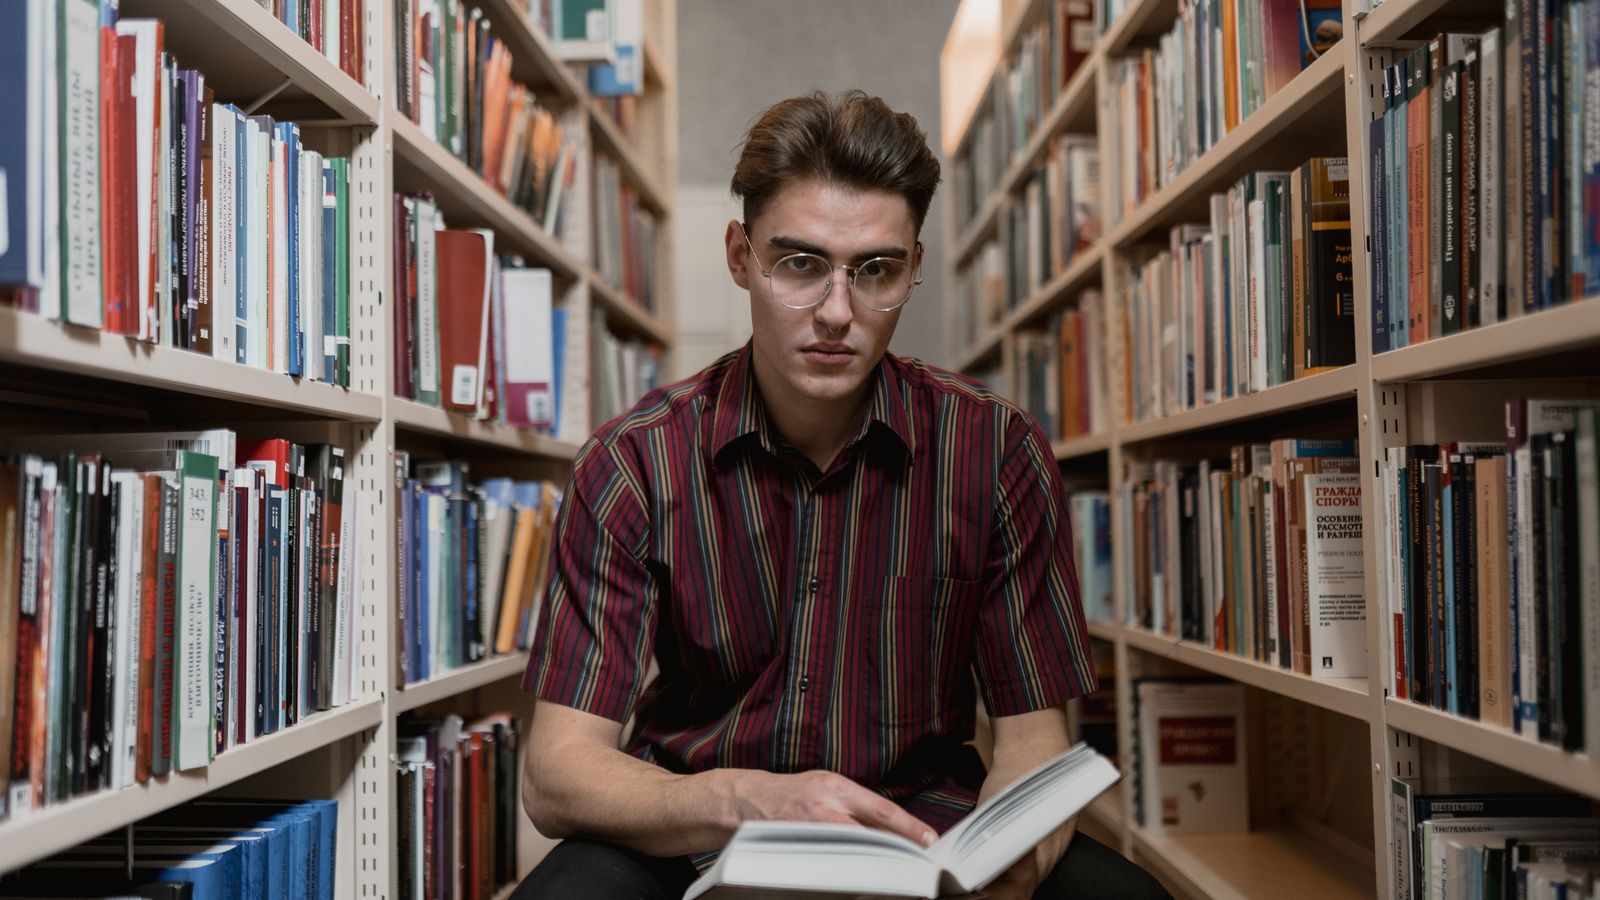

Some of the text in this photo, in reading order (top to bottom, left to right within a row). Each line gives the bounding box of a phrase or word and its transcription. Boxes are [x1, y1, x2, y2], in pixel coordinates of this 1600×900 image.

[1446, 178, 1454, 262] Прокурорский
[190, 488, 207, 500] 343.
[191, 508, 205, 520] 352
[1316, 497, 1359, 507] СПОРЫ
[1302, 545, 1310, 624] ГРАЖДАНСКИЙ
[1434, 498, 1443, 621] АДВОКАТУРА
[216, 668, 224, 721] ДАВАЙ
